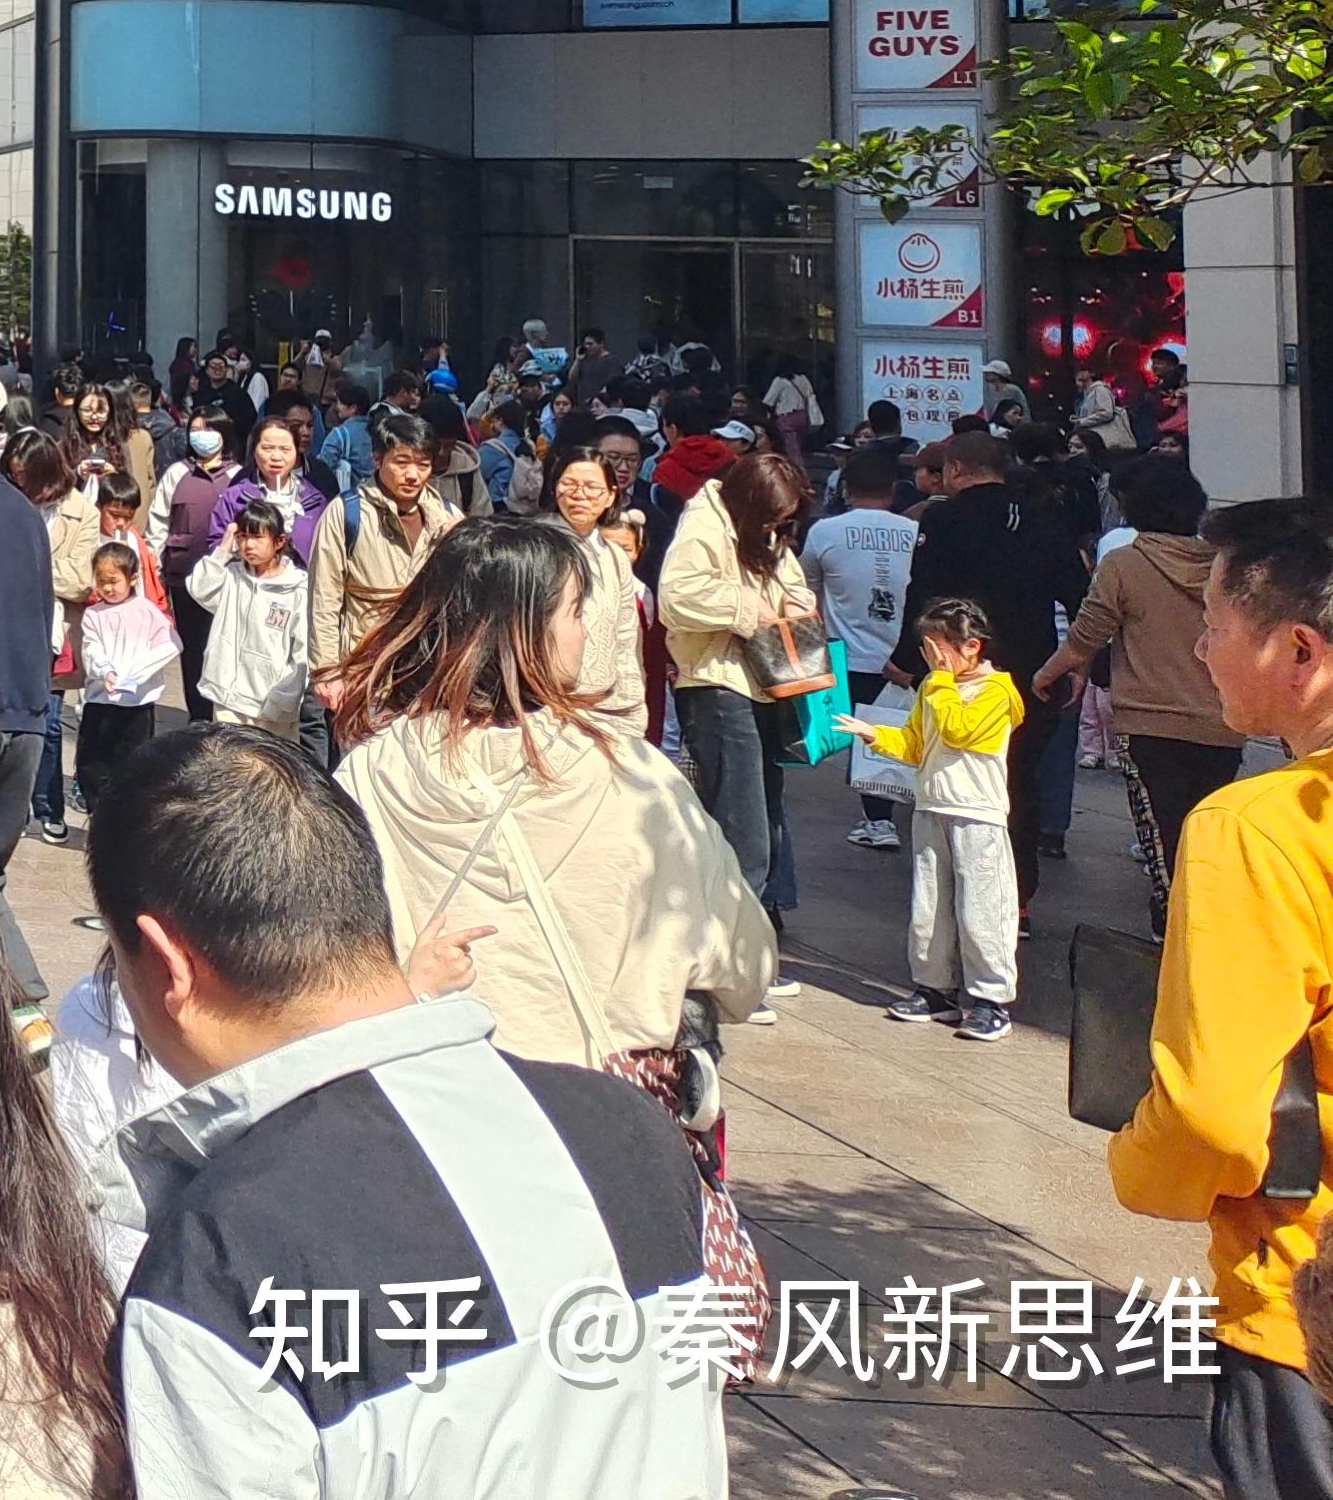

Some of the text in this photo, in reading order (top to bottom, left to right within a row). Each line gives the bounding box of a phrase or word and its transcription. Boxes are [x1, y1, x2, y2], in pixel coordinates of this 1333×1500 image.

[876, 9, 950, 32] FIVE
[868, 35, 960, 57] GUYS
[214, 183, 393, 222] SAMSUNG
[955, 190, 976, 204] L6
[877, 277, 966, 300] 小杨生煎
[957, 309, 980, 323] B1
[874, 355, 972, 381] 小杨生煎
[845, 526, 914, 553] PARIS
